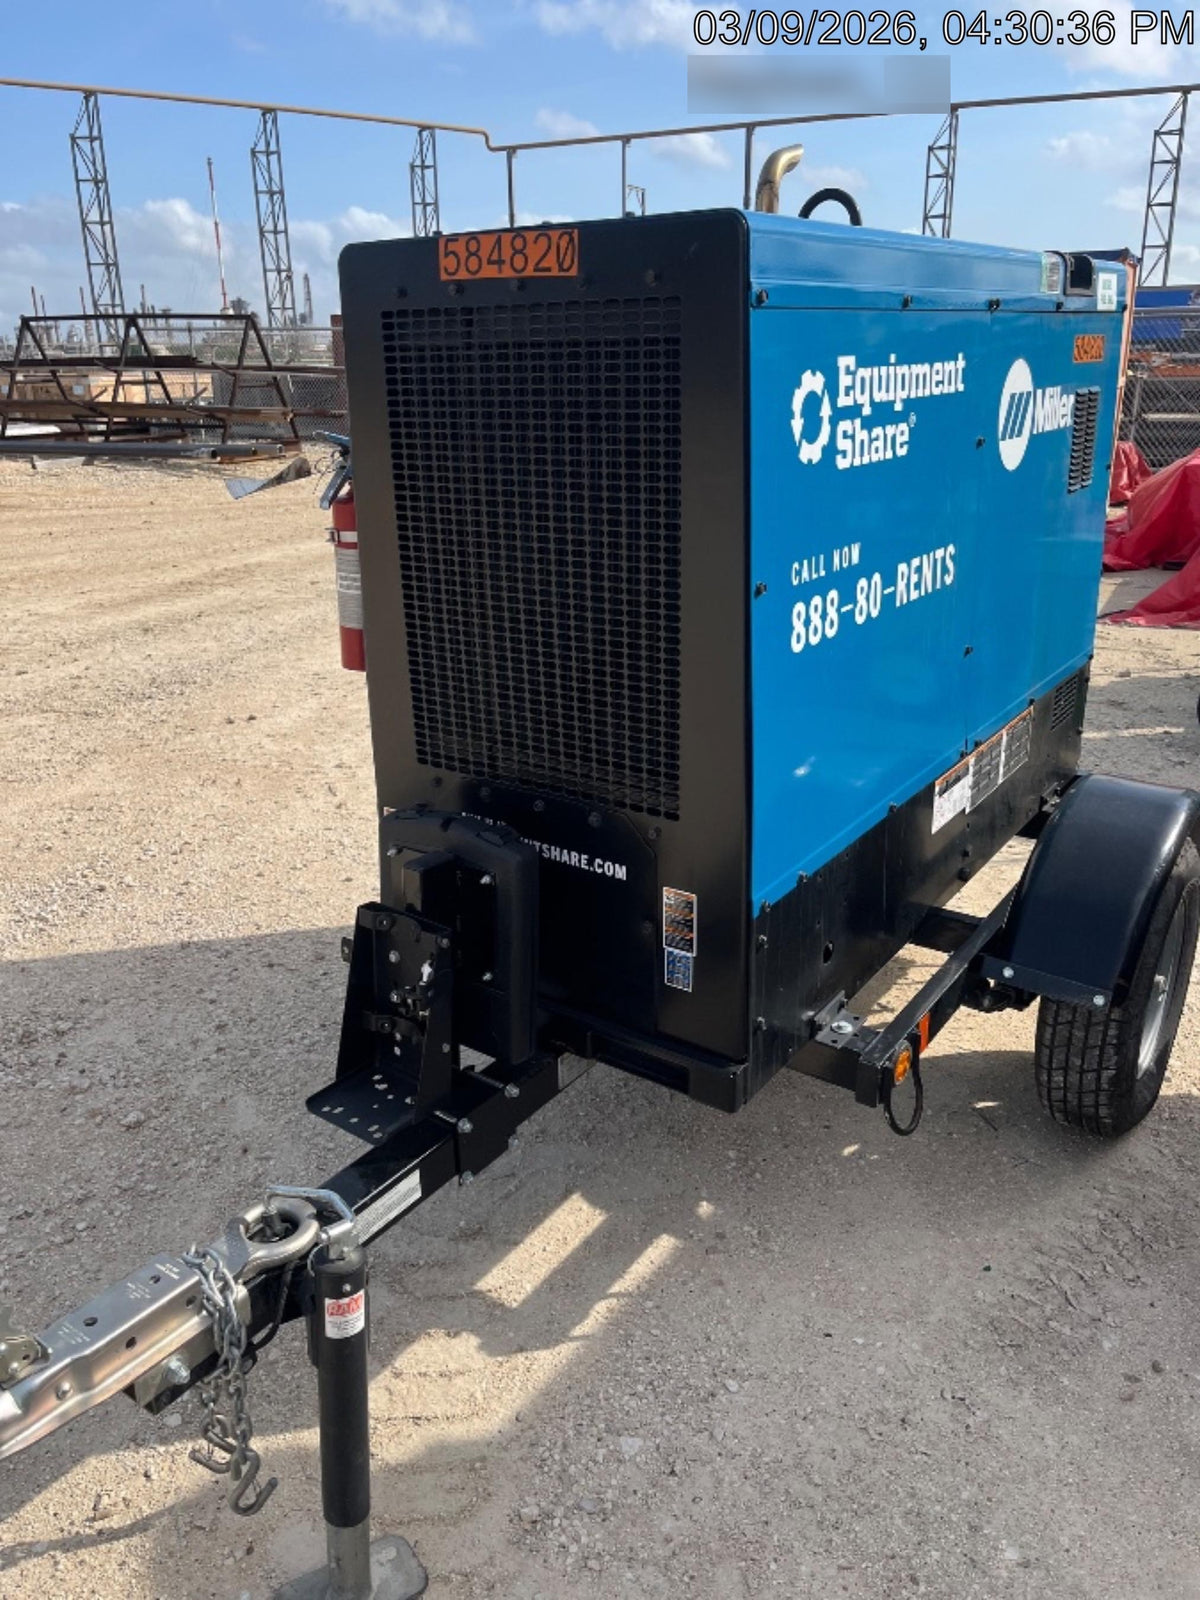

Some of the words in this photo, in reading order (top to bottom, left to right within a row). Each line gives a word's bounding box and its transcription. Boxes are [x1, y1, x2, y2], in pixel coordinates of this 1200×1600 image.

[443, 230, 577, 277] 584820
[836, 352, 966, 416] Equipment
[1032, 386, 1076, 434] Miller
[791, 554, 826, 586] CALL
[833, 542, 862, 572] NOW
[790, 543, 956, 654] 888-80-RENTS
[520, 837, 627, 881] TSHARE.COM
